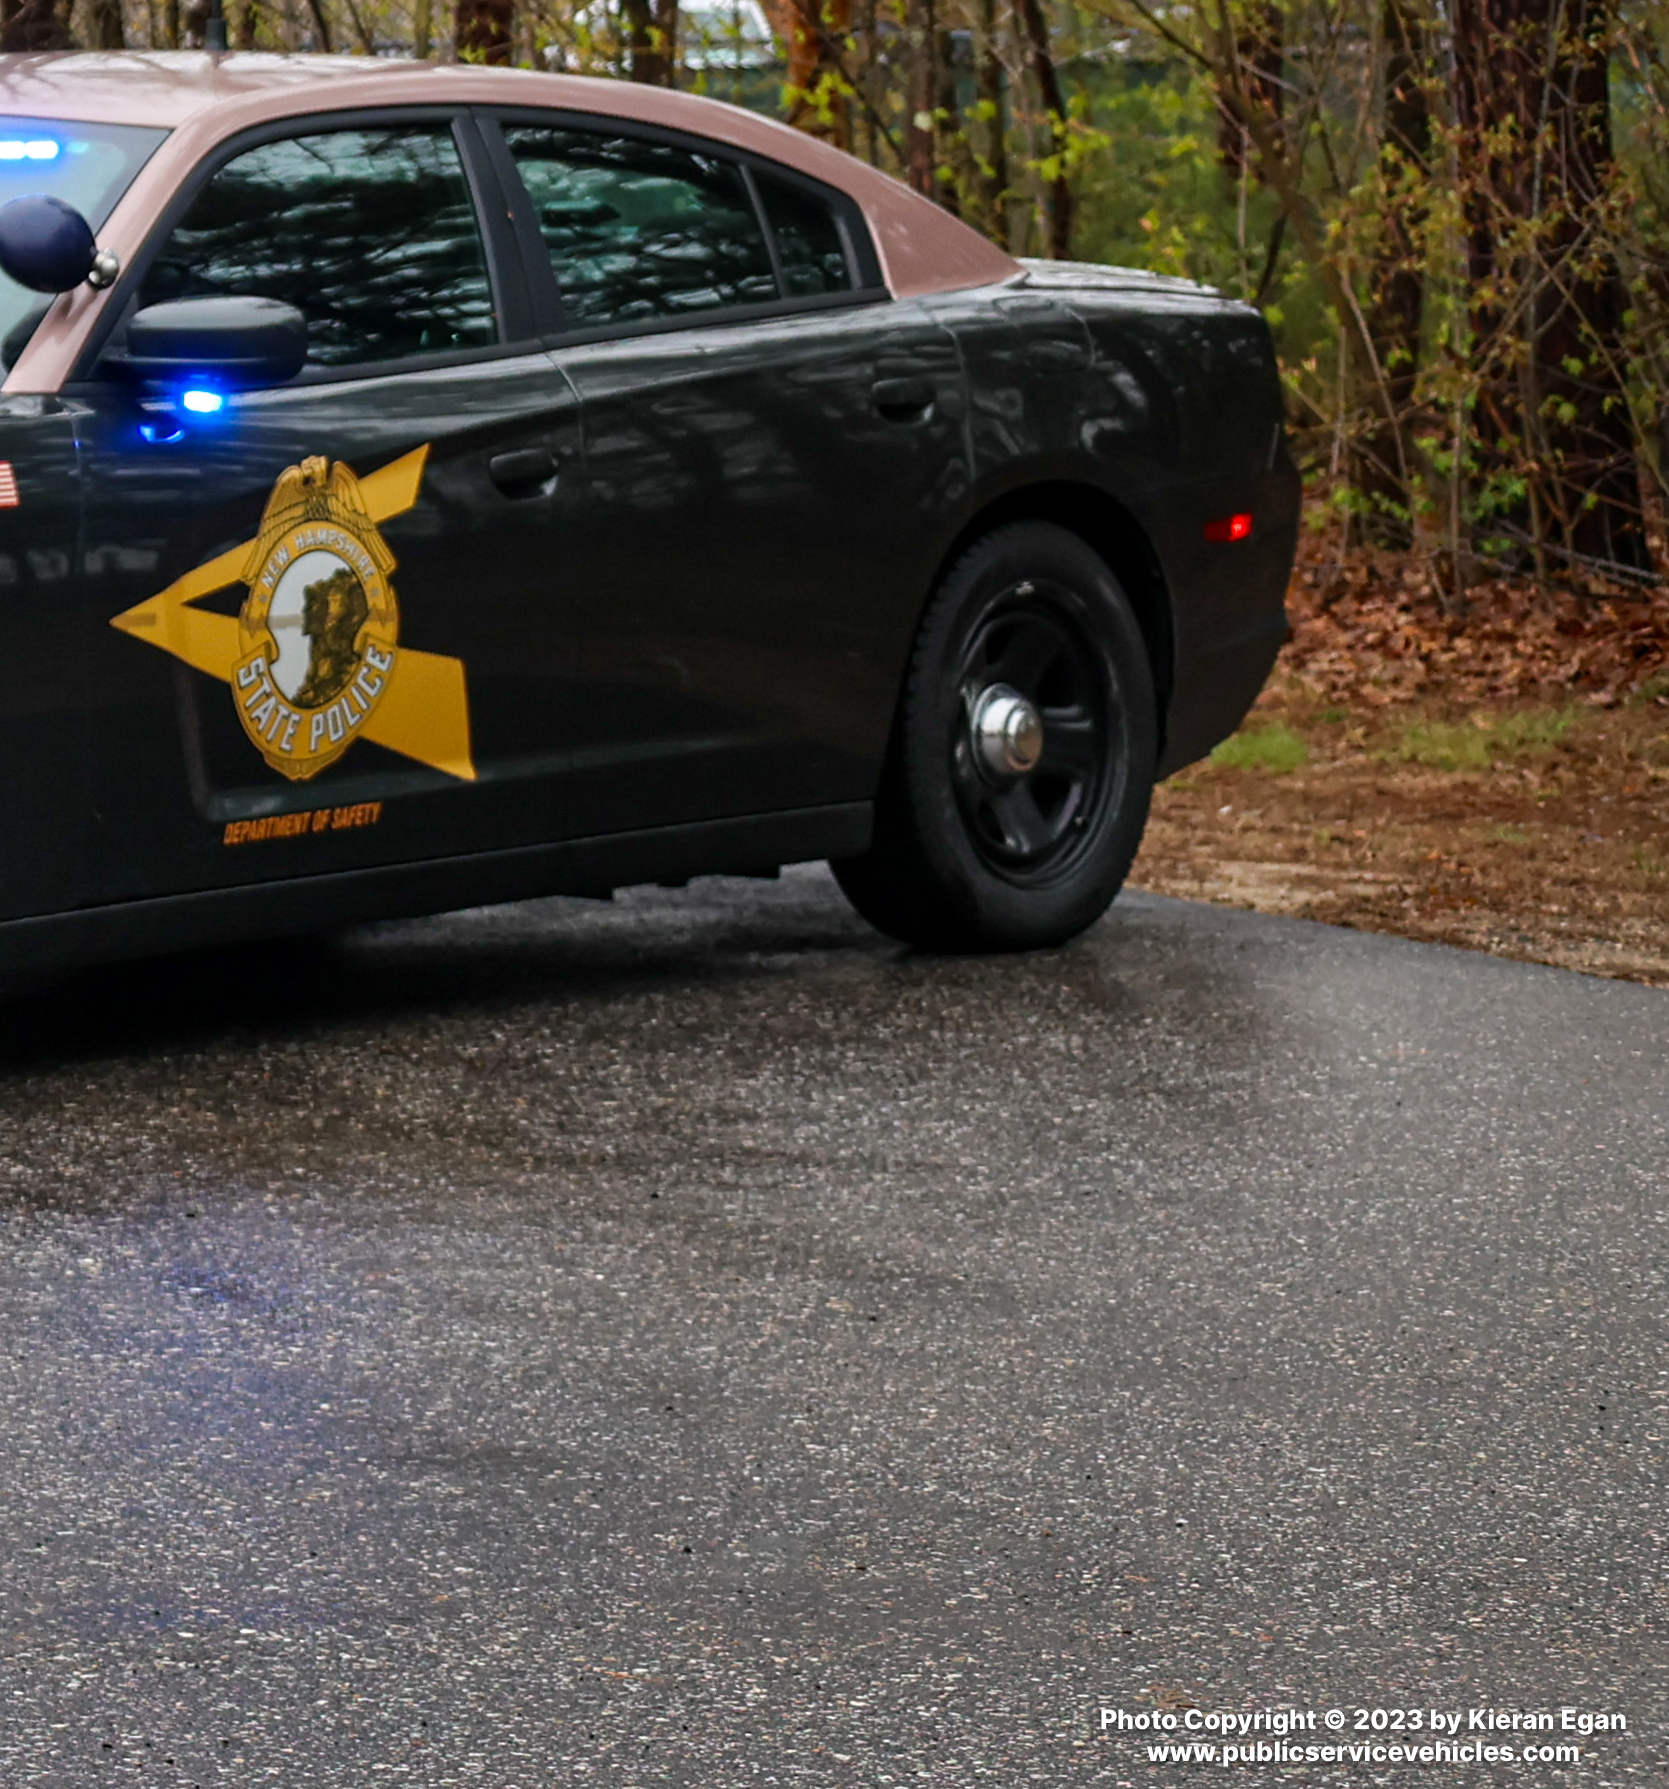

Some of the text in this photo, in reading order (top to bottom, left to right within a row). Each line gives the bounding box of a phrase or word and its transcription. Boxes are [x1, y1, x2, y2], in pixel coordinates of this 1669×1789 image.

[261, 527, 375, 588] NEW HAMPSHIRE
[237, 642, 394, 753] STATE POLICE
[224, 801, 383, 845] DEPARTMENT OF SAFETY
